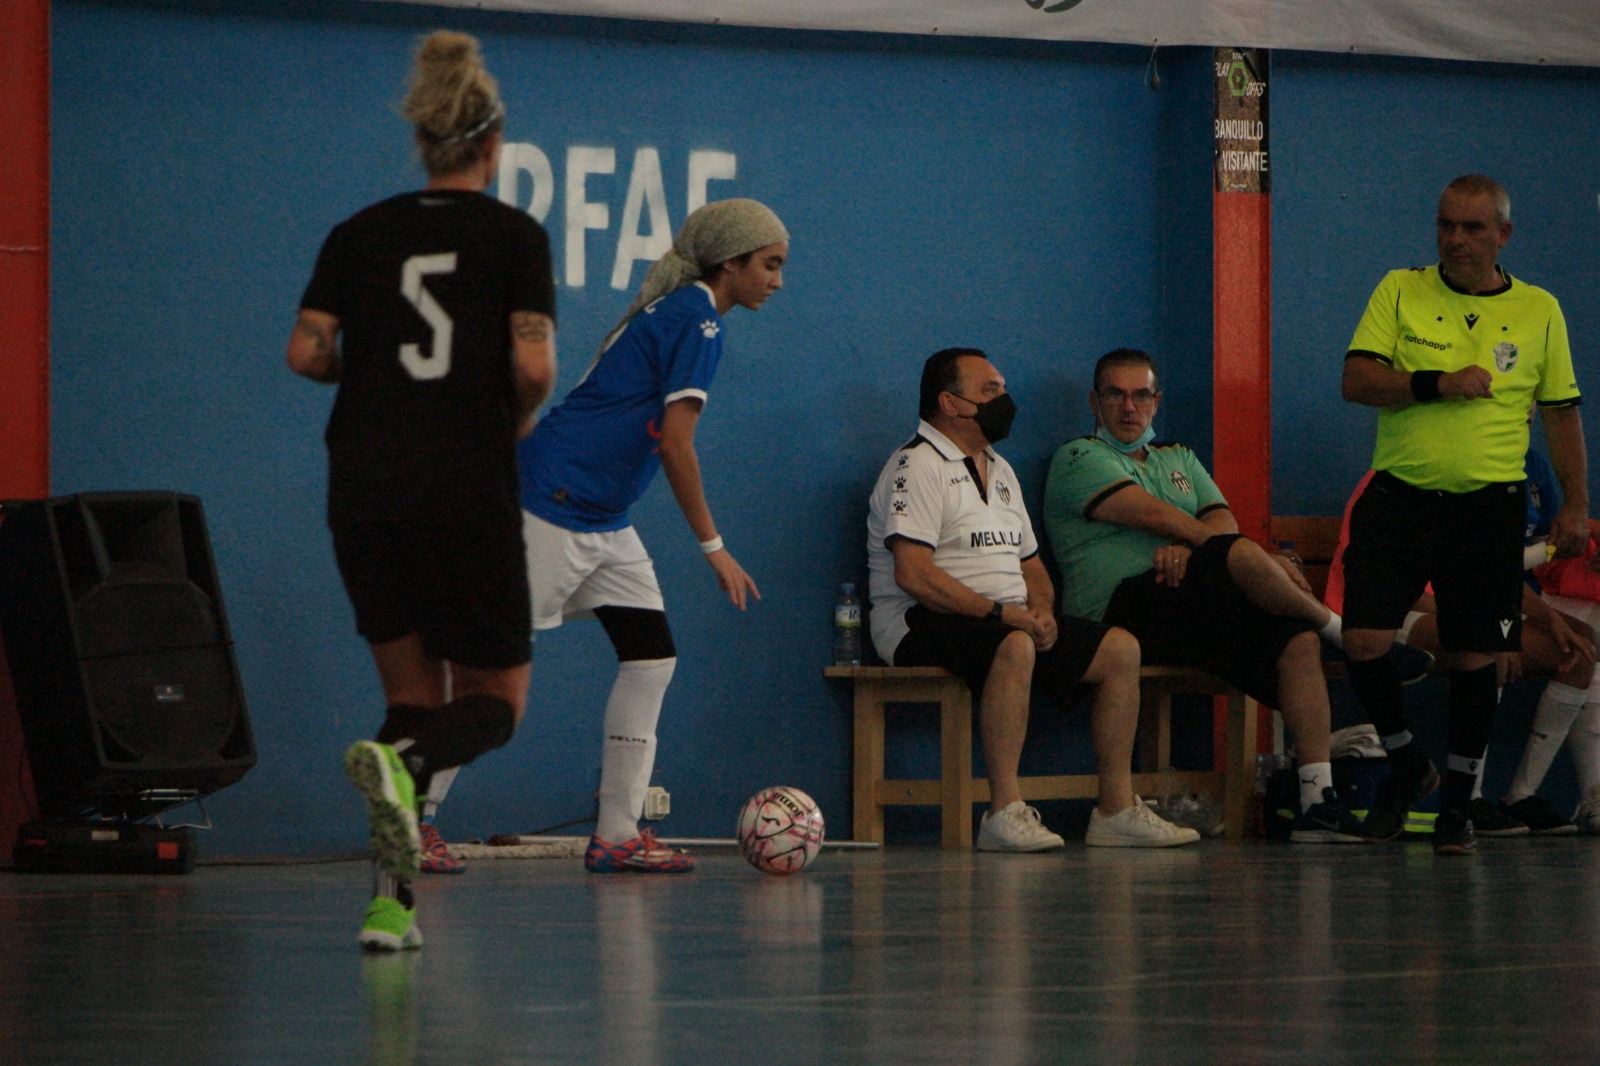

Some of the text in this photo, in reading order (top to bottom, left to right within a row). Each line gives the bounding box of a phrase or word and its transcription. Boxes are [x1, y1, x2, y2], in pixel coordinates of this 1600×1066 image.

[1246, 81, 1266, 97] OFFS
[1215, 119, 1264, 141] BANQUILLO
[1222, 150, 1268, 172] VISITANTE
[398, 251, 458, 382] 5
